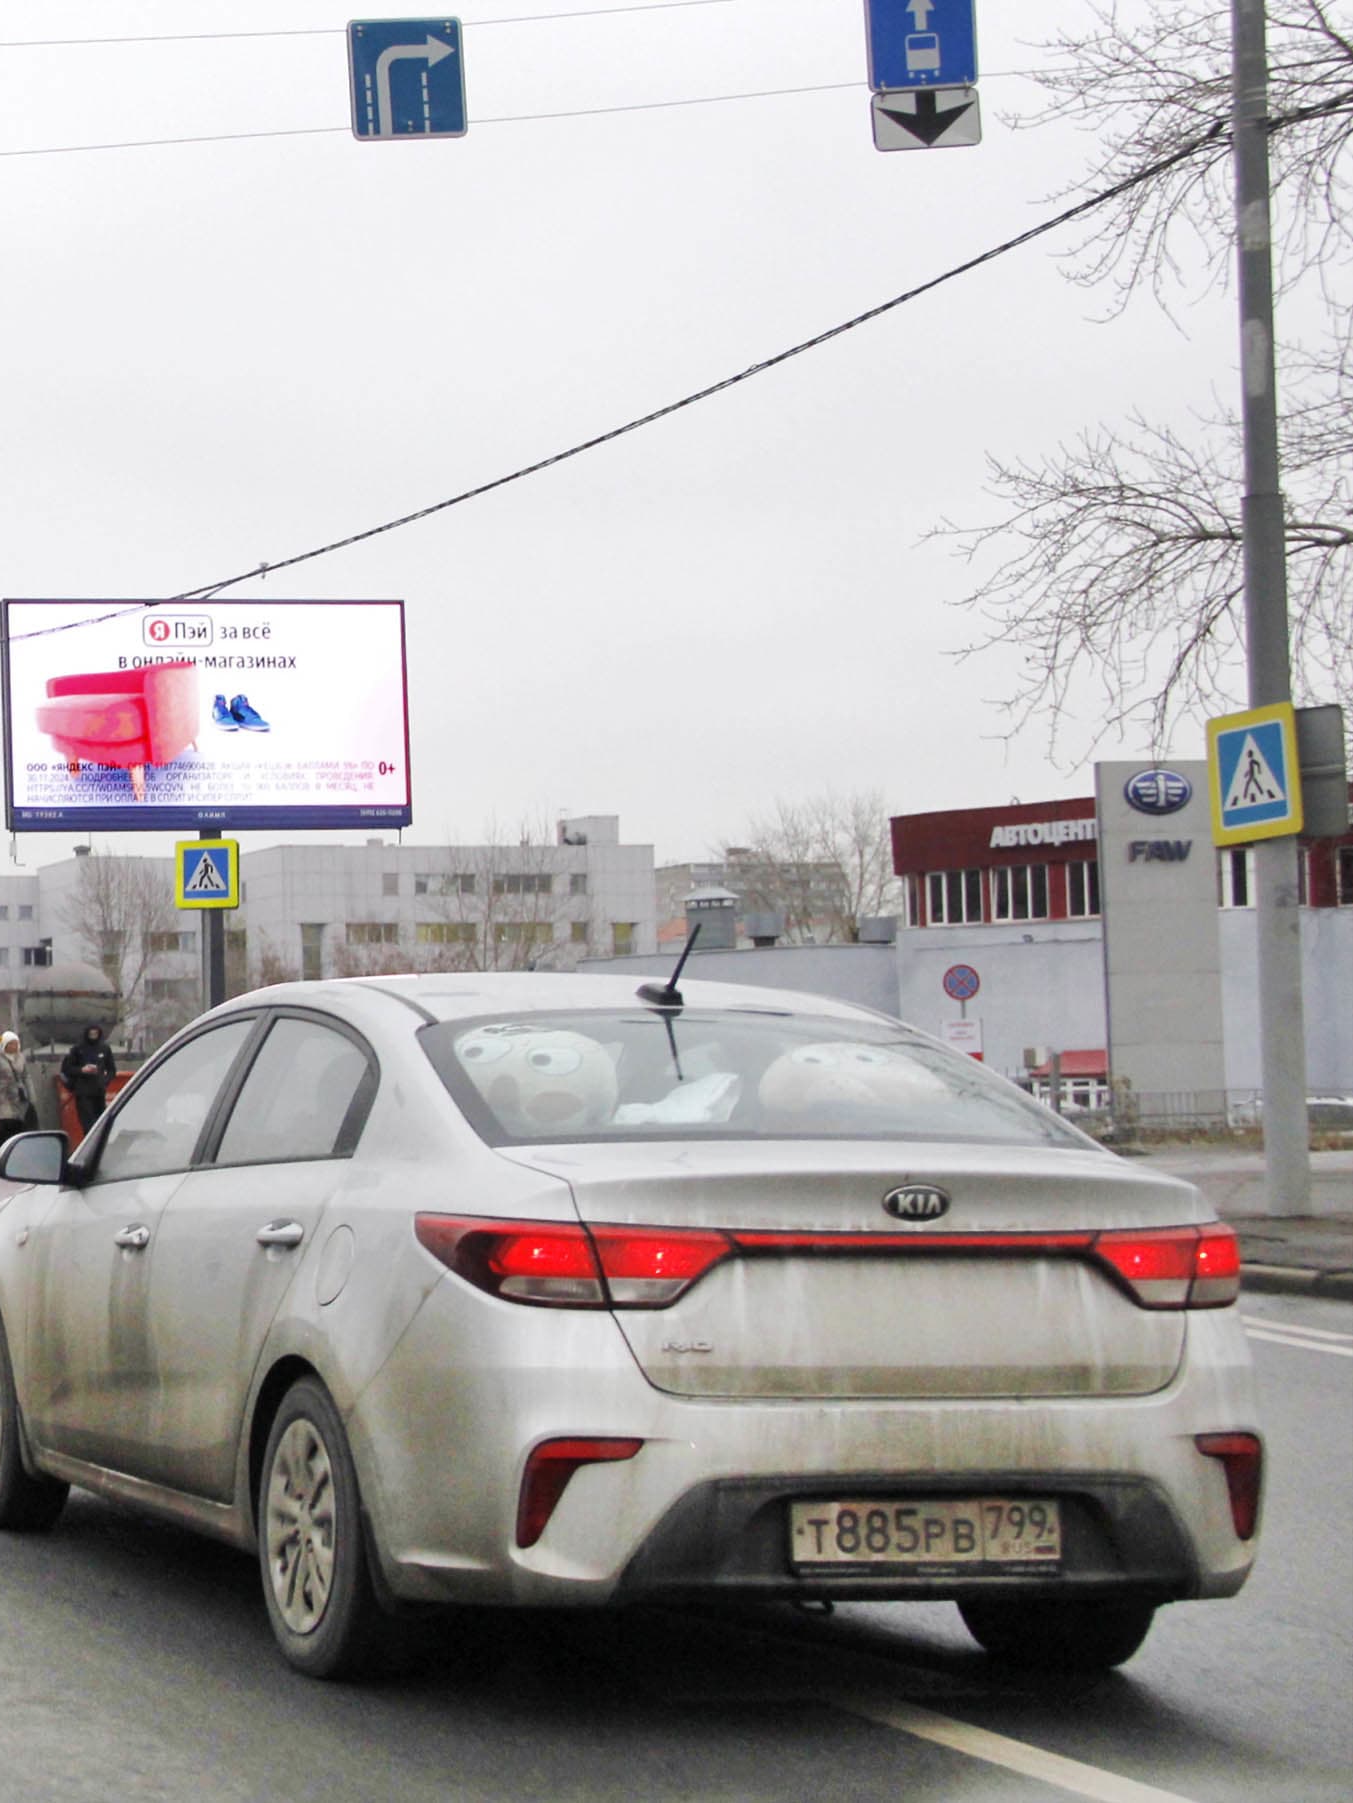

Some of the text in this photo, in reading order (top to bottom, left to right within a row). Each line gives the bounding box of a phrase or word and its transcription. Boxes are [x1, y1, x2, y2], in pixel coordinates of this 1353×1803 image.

[174, 621, 207, 640] Пэй
[220, 626, 238, 640] за
[242, 622, 272, 640] всё
[118, 656, 128, 670] в
[26, 763, 48, 772] ООО
[378, 760, 396, 776] 0+
[989, 818, 1097, 848] АВТОЦЕНТ
[1127, 839, 1193, 862] FAW
[897, 1192, 942, 1215] KIA
[985, 1504, 1048, 1541] 799
